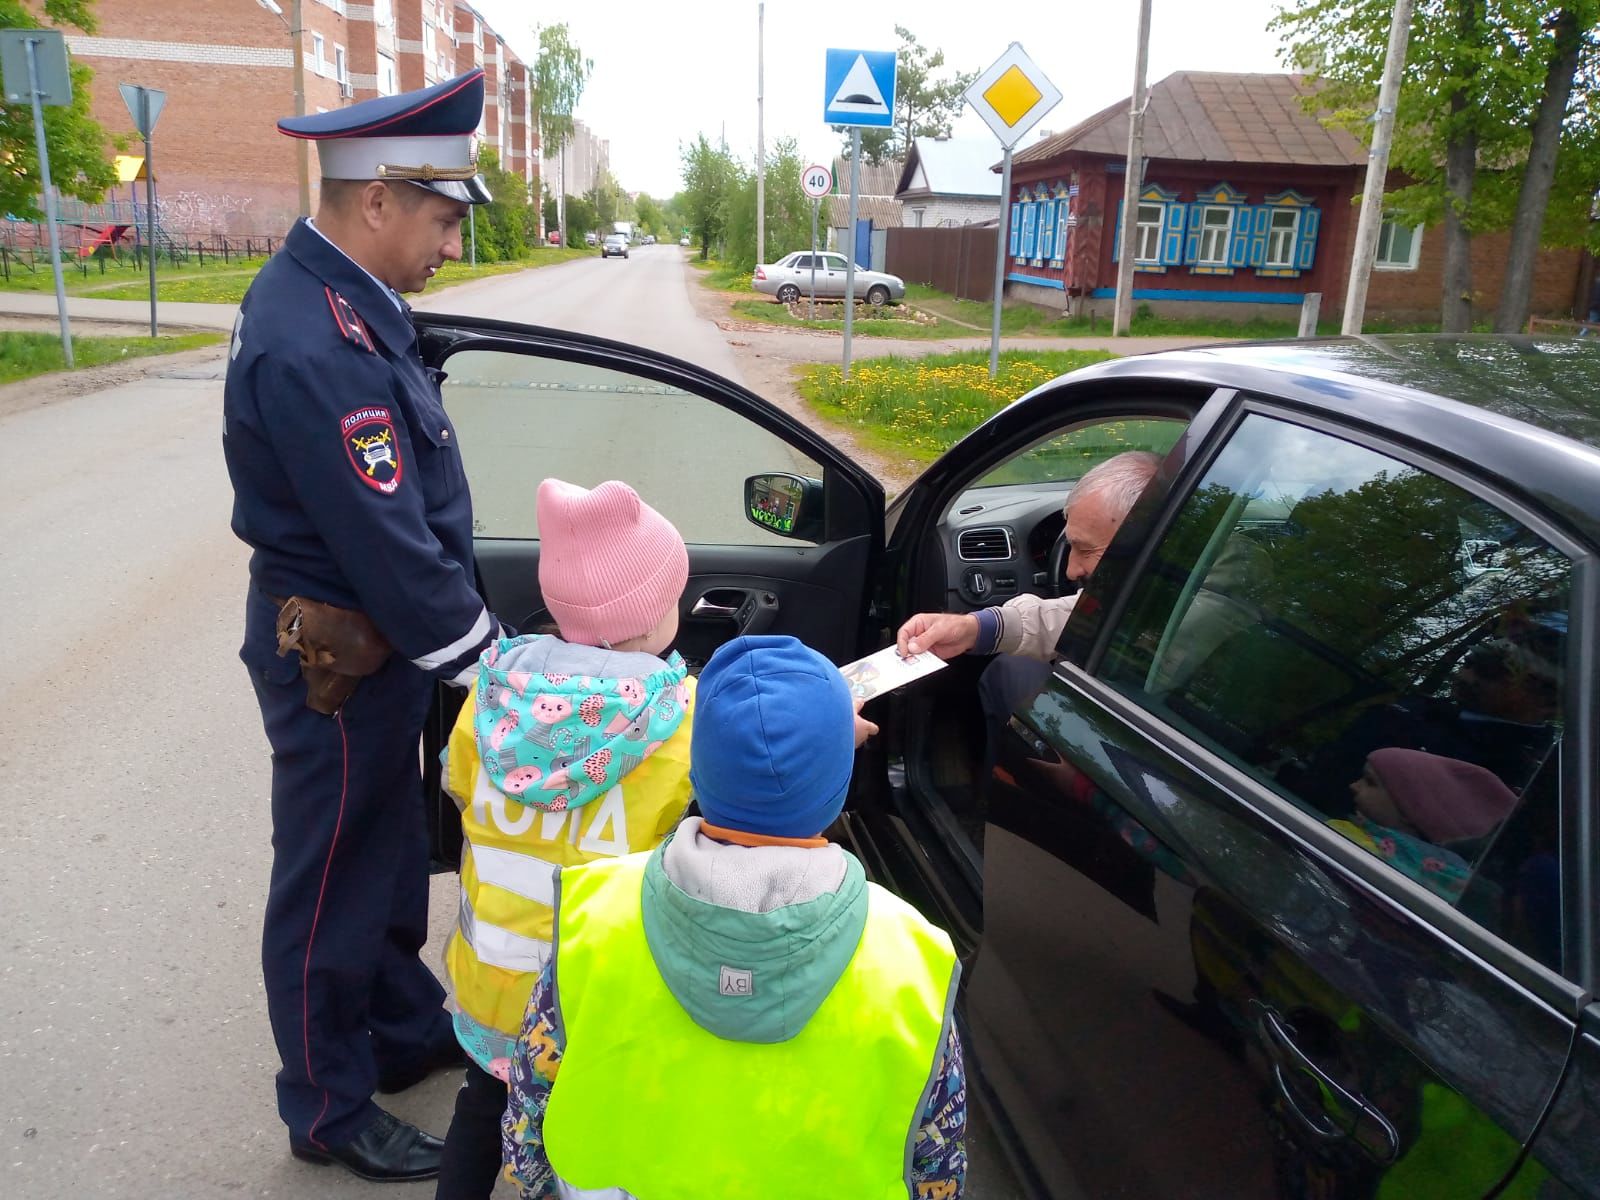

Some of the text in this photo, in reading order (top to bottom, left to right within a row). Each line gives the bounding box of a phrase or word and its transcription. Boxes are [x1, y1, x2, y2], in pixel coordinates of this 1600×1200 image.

[809, 175, 825, 188] 40
[344, 409, 387, 428] ПОЛИЦИЯ
[724, 975, 747, 993] BY
